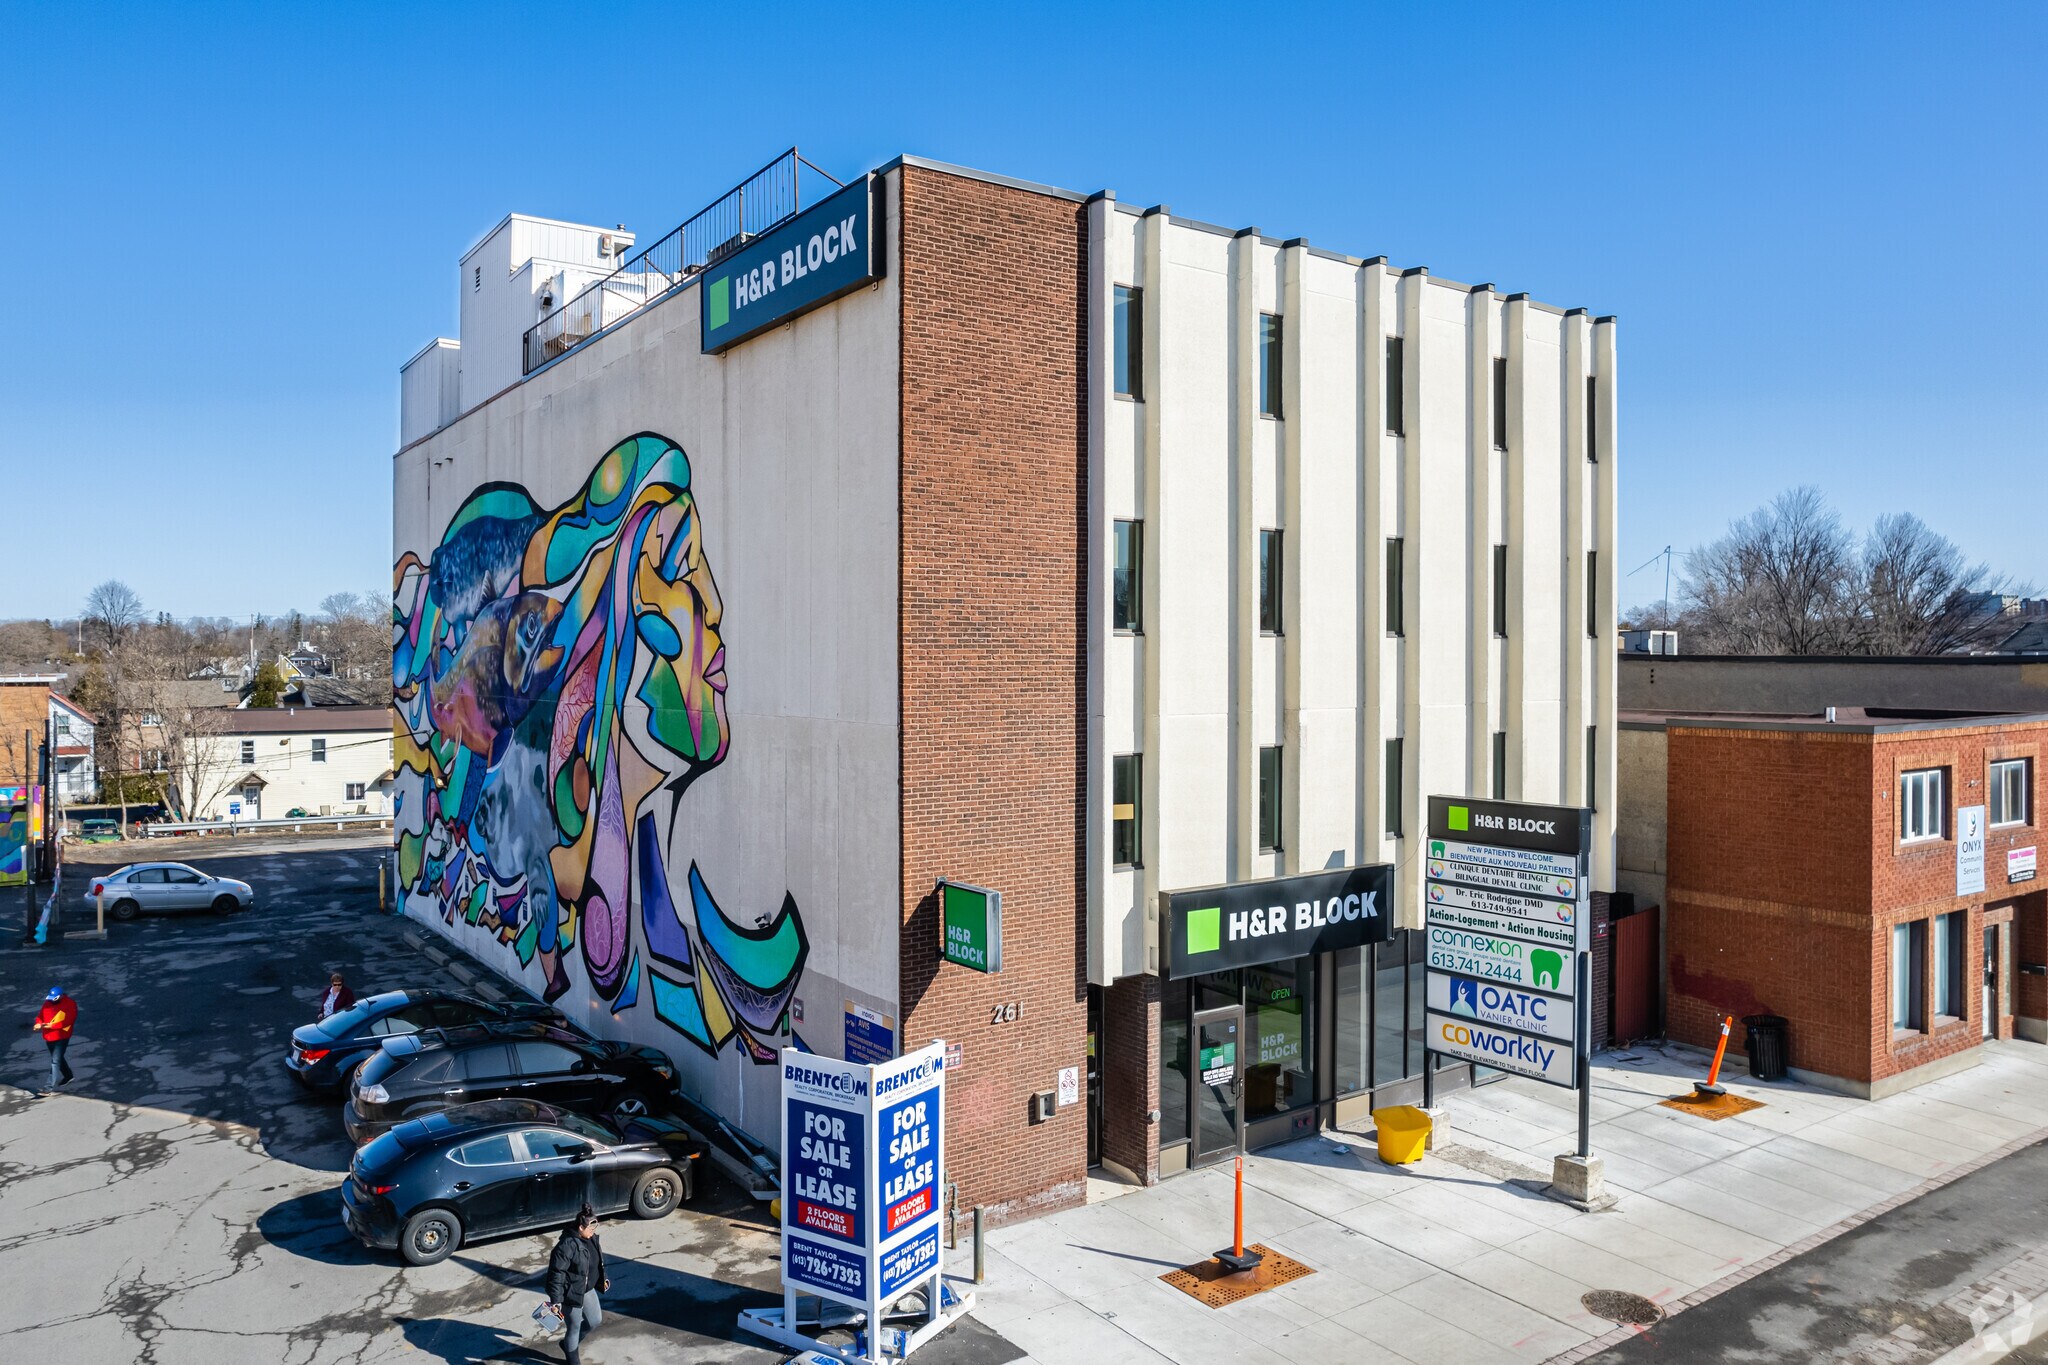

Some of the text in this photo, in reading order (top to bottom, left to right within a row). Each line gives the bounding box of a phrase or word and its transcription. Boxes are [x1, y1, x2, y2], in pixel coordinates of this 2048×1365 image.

[735, 214, 857, 310] H&R BLOCK
[1475, 814, 1555, 835] H&R BLOCK
[1467, 846, 1553, 862] NEW PATIENTS WELCOME
[1962, 840, 1982, 853] ONYX
[1450, 852, 1573, 875] BIENVENUE AUX NOUVEAU PATIENTS
[1450, 862, 1550, 883] CLINIQUE DENTAIRE BILINGUE
[1455, 872, 1544, 892] BILINGUAL DENTAL CLINIC
[1456, 888, 1543, 909] Dr. Eric Rodrigue DMD
[1471, 900, 1528, 916] 613-749-9541
[1229, 891, 1378, 941] H&R BLOCK
[1429, 908, 1574, 942] Action-Logement Action Housing
[948, 925, 971, 944] H&R
[1432, 929, 1522, 959] connexion
[948, 941, 984, 964] BLOCK
[1432, 952, 1522, 982] 613.741.2444
[1271, 988, 1290, 1000] OPEN
[1481, 987, 1547, 1021] OATC
[994, 1001, 1024, 1024] 261
[1480, 1010, 1548, 1034] VANIER CLINIC
[1261, 1033, 1285, 1048] H&R
[1261, 1042, 1298, 1062] BLOCK
[1442, 1023, 1555, 1072] coworkly
[1450, 1049, 1462, 1057] TAKE
[1463, 1052, 1472, 1060] THE
[1473, 1054, 1498, 1066] ELEVATOR
[1507, 1063, 1516, 1071] THE
[1518, 1066, 1527, 1074] 3RD
[1529, 1070, 1546, 1078] FLOOR
[785, 1064, 868, 1096] BRENTCOM
[876, 1055, 942, 1097] BRENTCOM
[835, 1092, 856, 1102] BROKERAGE
[804, 1110, 846, 1142] FOR
[893, 1101, 927, 1136] FOR
[800, 1136, 851, 1170] SALE
[889, 1124, 930, 1164] SALE
[818, 1166, 832, 1178] OR
[904, 1156, 916, 1170] OR
[795, 1173, 857, 1211] LEASE
[885, 1160, 933, 1206] LEASE
[807, 1206, 845, 1224] 2 FLOORS
[893, 1201, 926, 1228] AVAILABLE
[894, 1194, 925, 1217] 2 FLOORS
[805, 1215, 847, 1234] AVAILABLE
[792, 1254, 806, 1268] (613)
[793, 1242, 837, 1261] BRENT TAYLOR
[884, 1240, 919, 1266] BRENT TAYLOR
[801, 1273, 854, 1293] www.brentcomrealty.com
[883, 1267, 895, 1282] (613)
